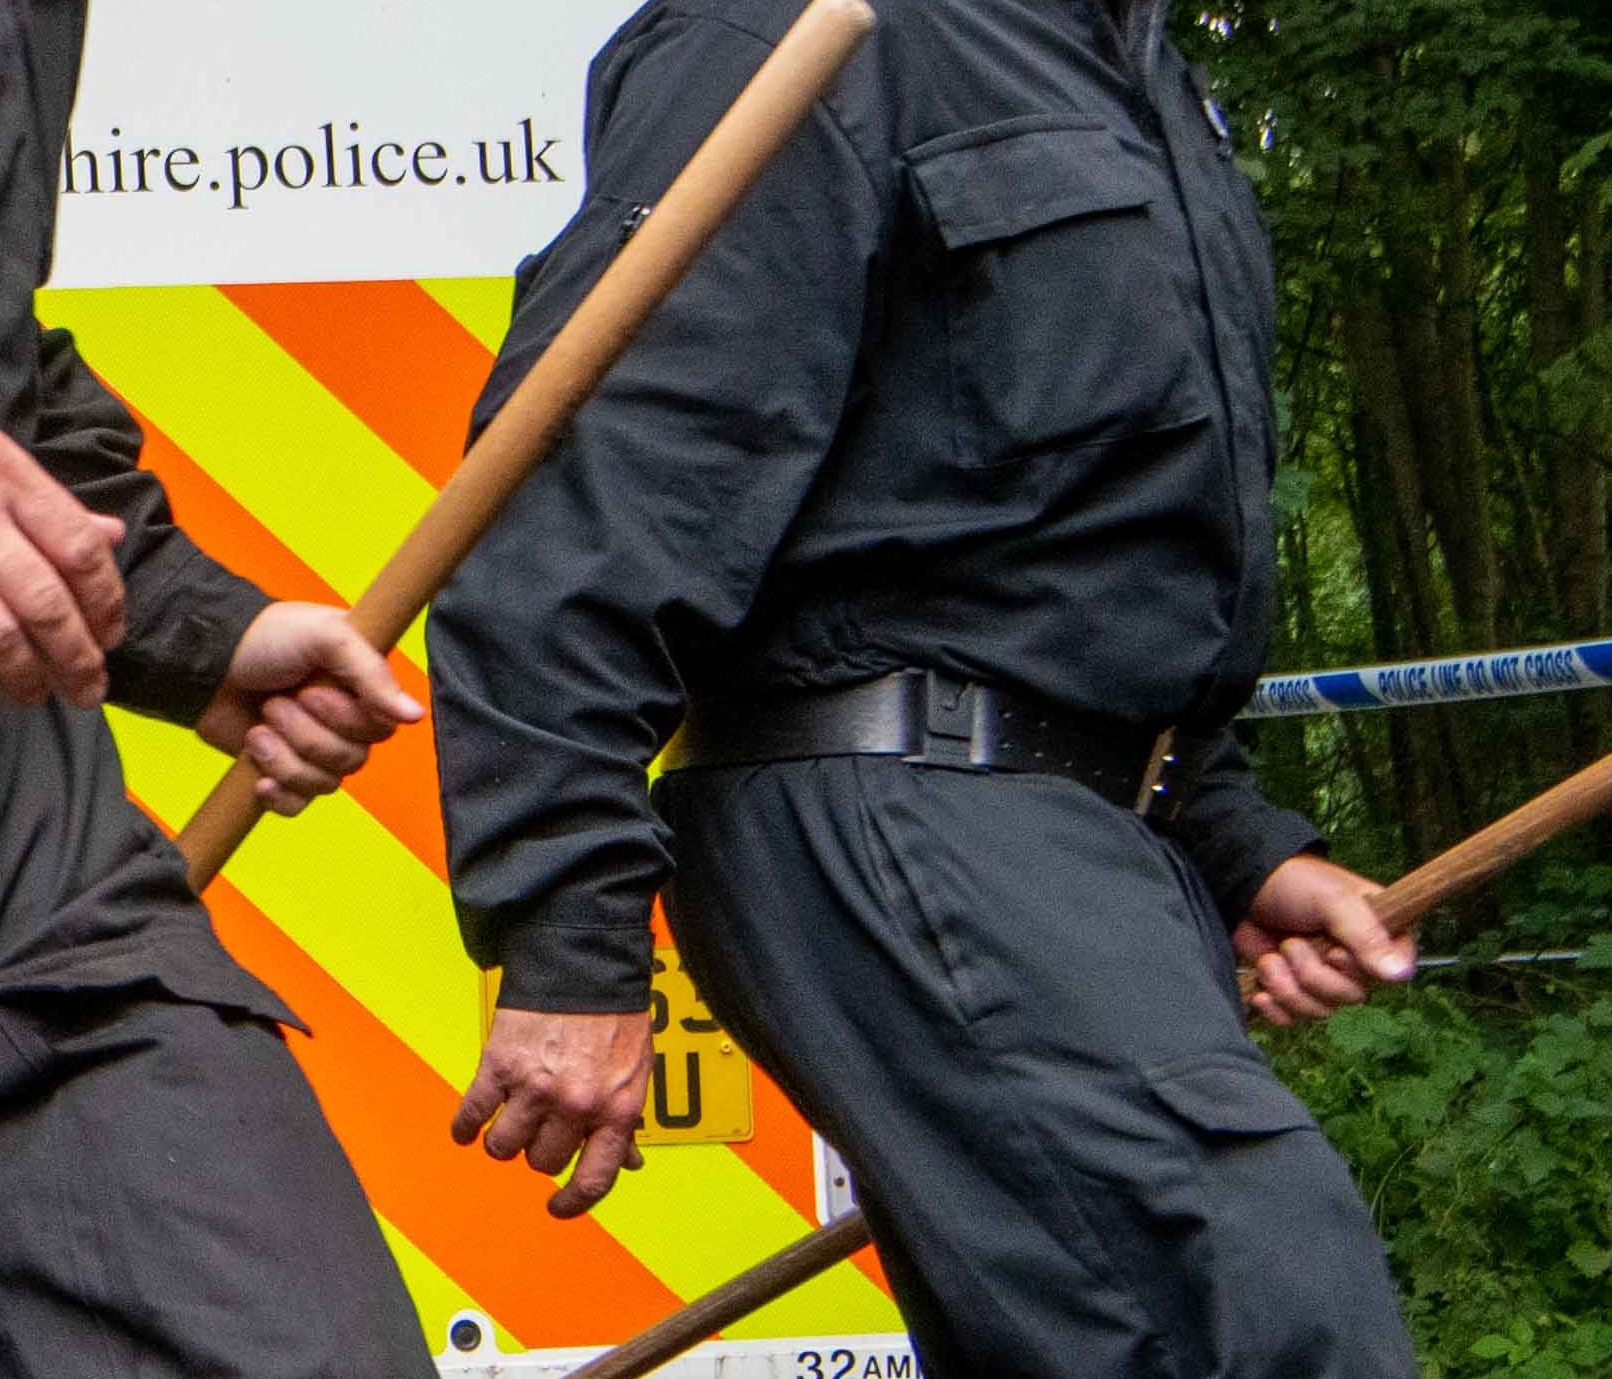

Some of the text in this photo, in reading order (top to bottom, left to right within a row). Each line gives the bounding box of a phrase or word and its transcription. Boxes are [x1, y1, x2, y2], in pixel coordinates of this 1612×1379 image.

[1378, 649, 1581, 701] POLICE LINE DO NOT CROSS
